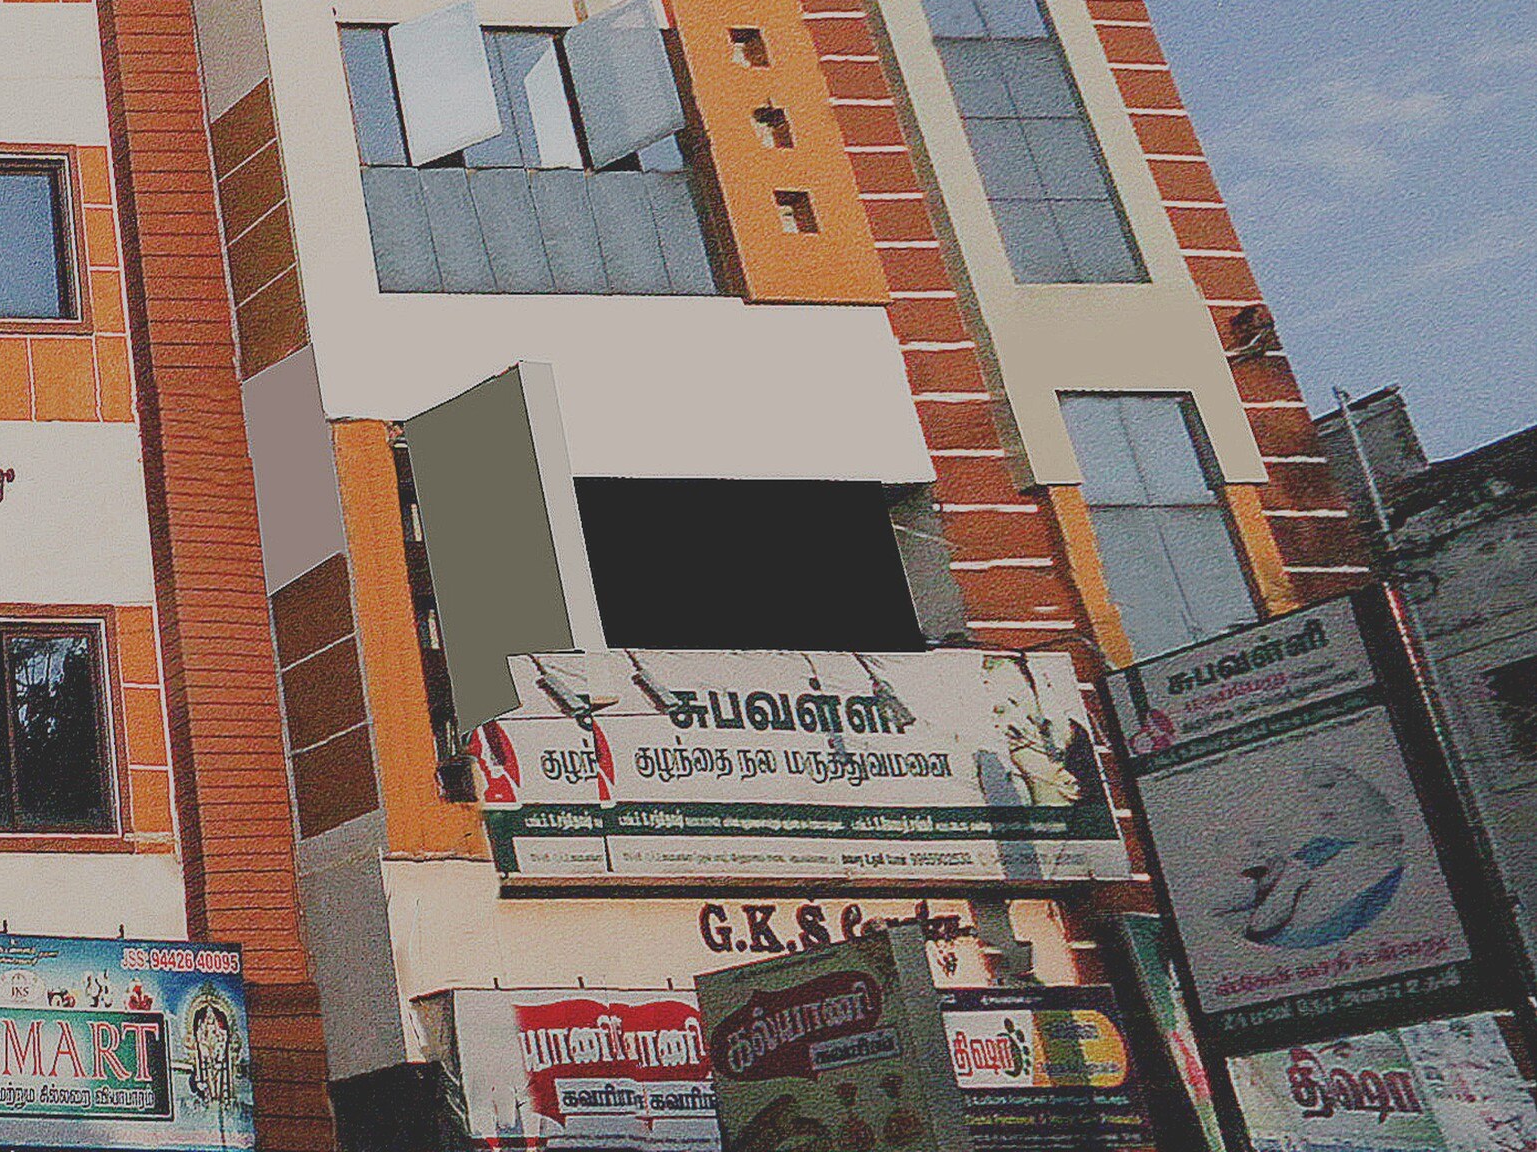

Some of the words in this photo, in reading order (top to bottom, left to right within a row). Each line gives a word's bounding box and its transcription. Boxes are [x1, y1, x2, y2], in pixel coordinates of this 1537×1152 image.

[739, 747, 777, 780] நல
[150, 950, 194, 971] 94426
[195, 951, 239, 973] 40095
[1, 1018, 159, 1083] MART
